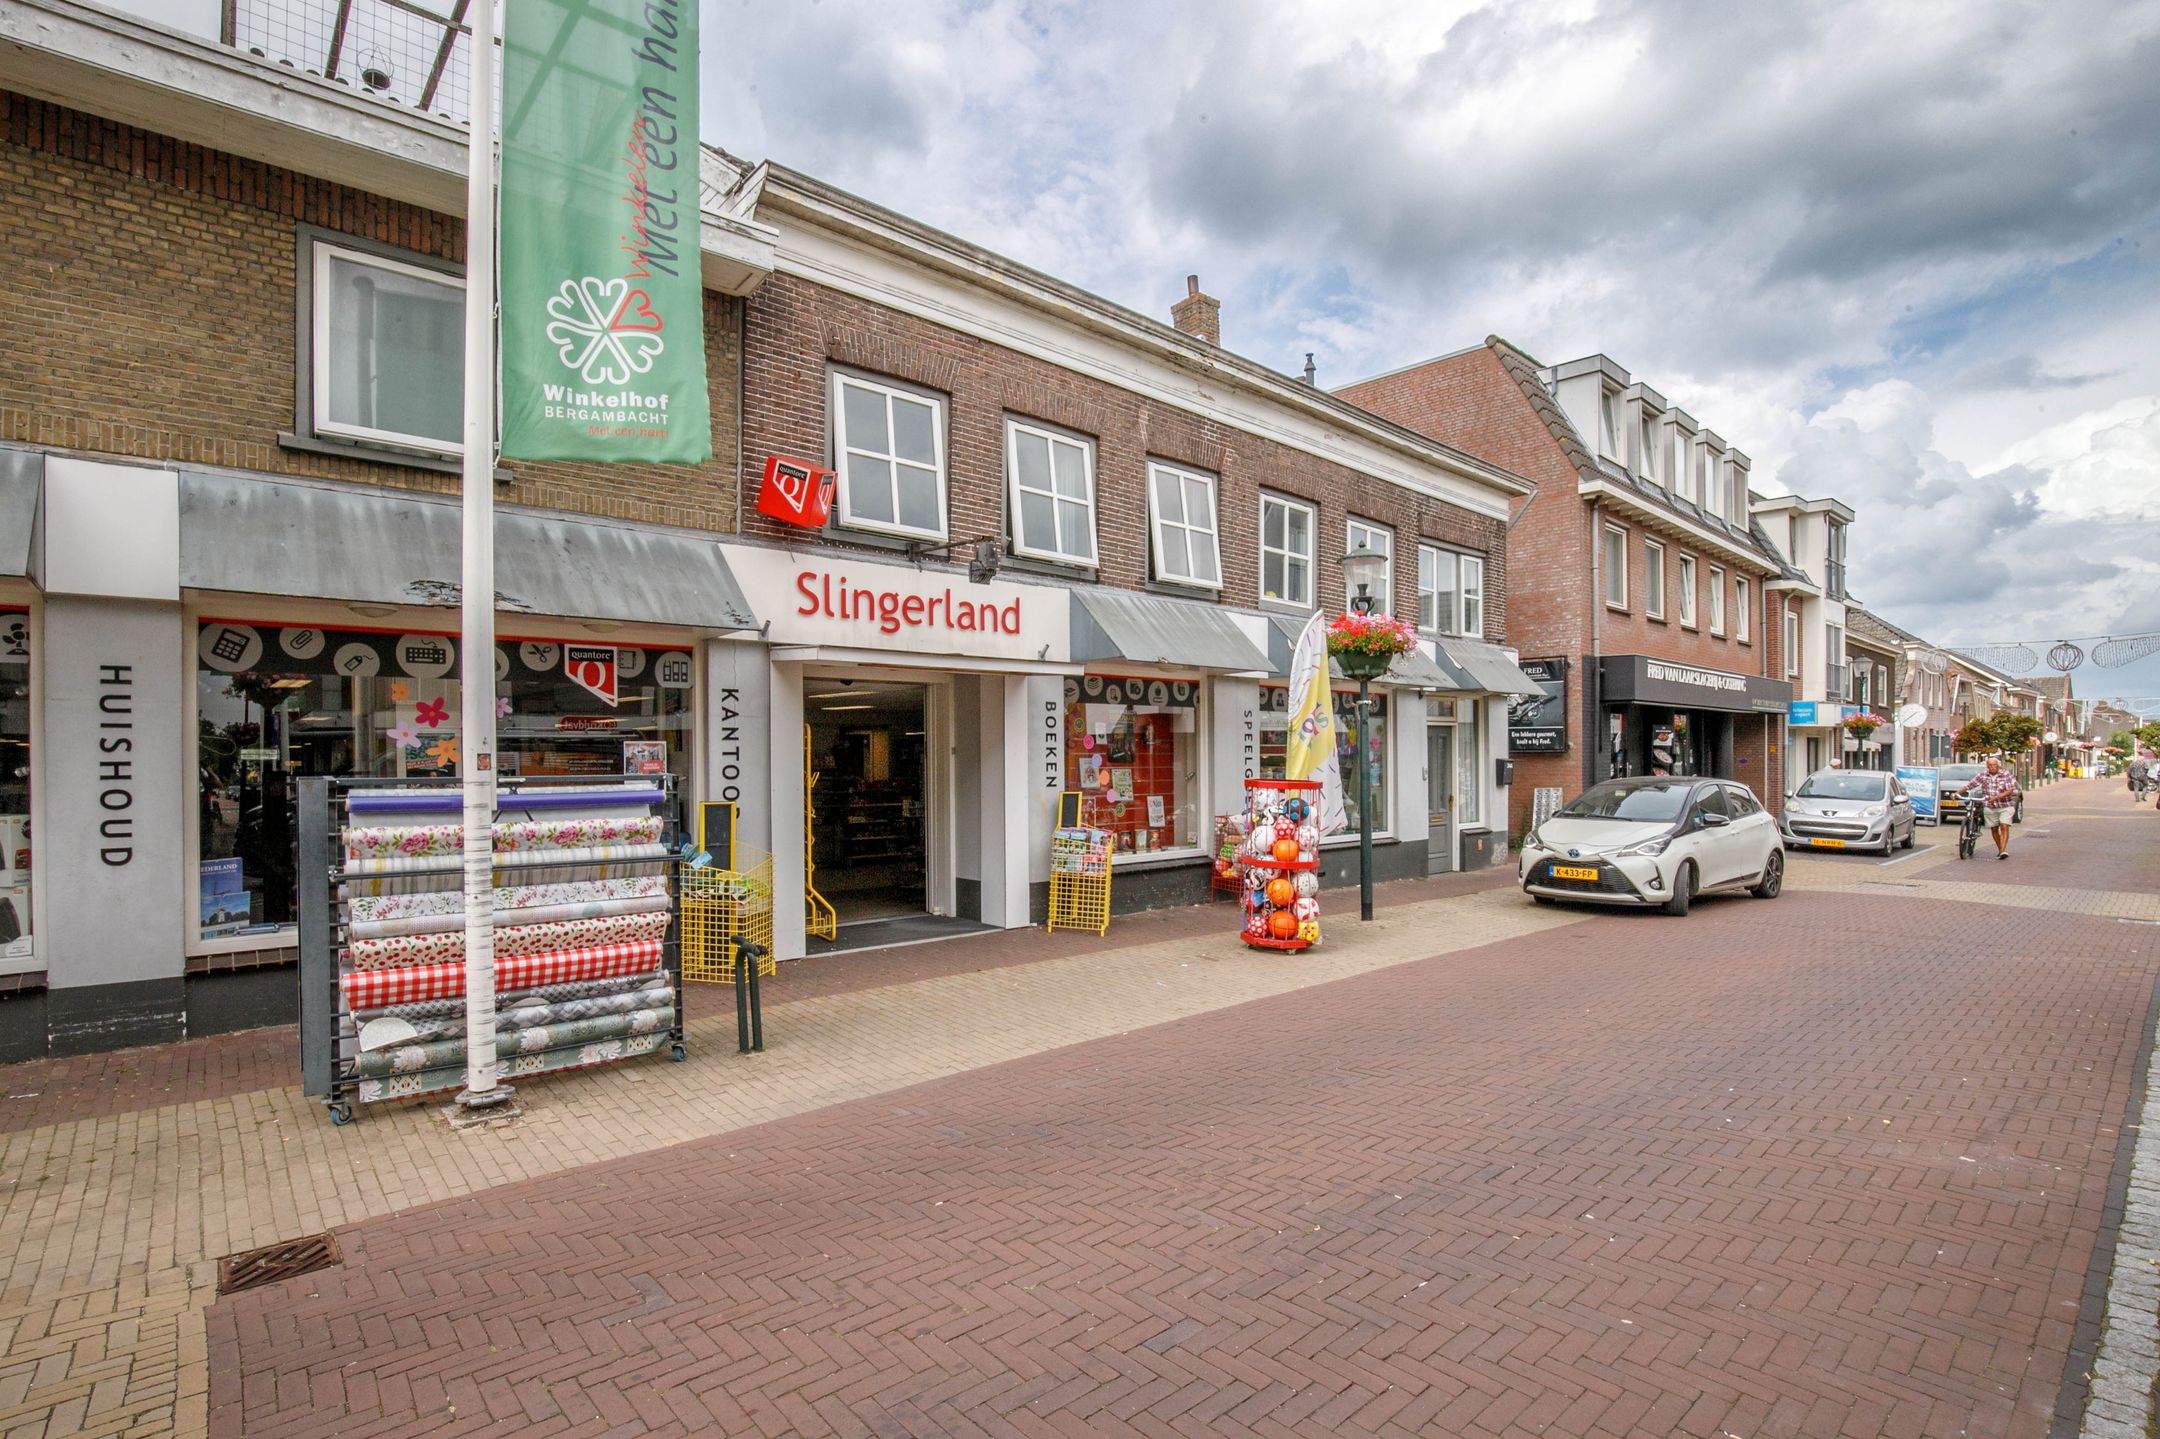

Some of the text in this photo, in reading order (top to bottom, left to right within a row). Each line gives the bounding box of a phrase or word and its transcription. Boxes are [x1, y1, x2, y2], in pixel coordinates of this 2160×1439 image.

[631, 0, 678, 277] Met een ha
[543, 383, 669, 410] Winkelhof
[544, 405, 669, 425] BERGAMBACHT
[588, 425, 610, 437] Met
[614, 427, 635, 437] een
[779, 475, 800, 502] Q
[797, 571, 1021, 634] Slingerland
[1647, 663, 1664, 679] FRED
[1664, 666, 1679, 682] VAN
[721, 688, 740, 820] KANTOO
[1045, 701, 1057, 788] BOEKEN
[99, 665, 132, 867] HUISHOUD
[1556, 868, 1593, 877] K-433-FP
